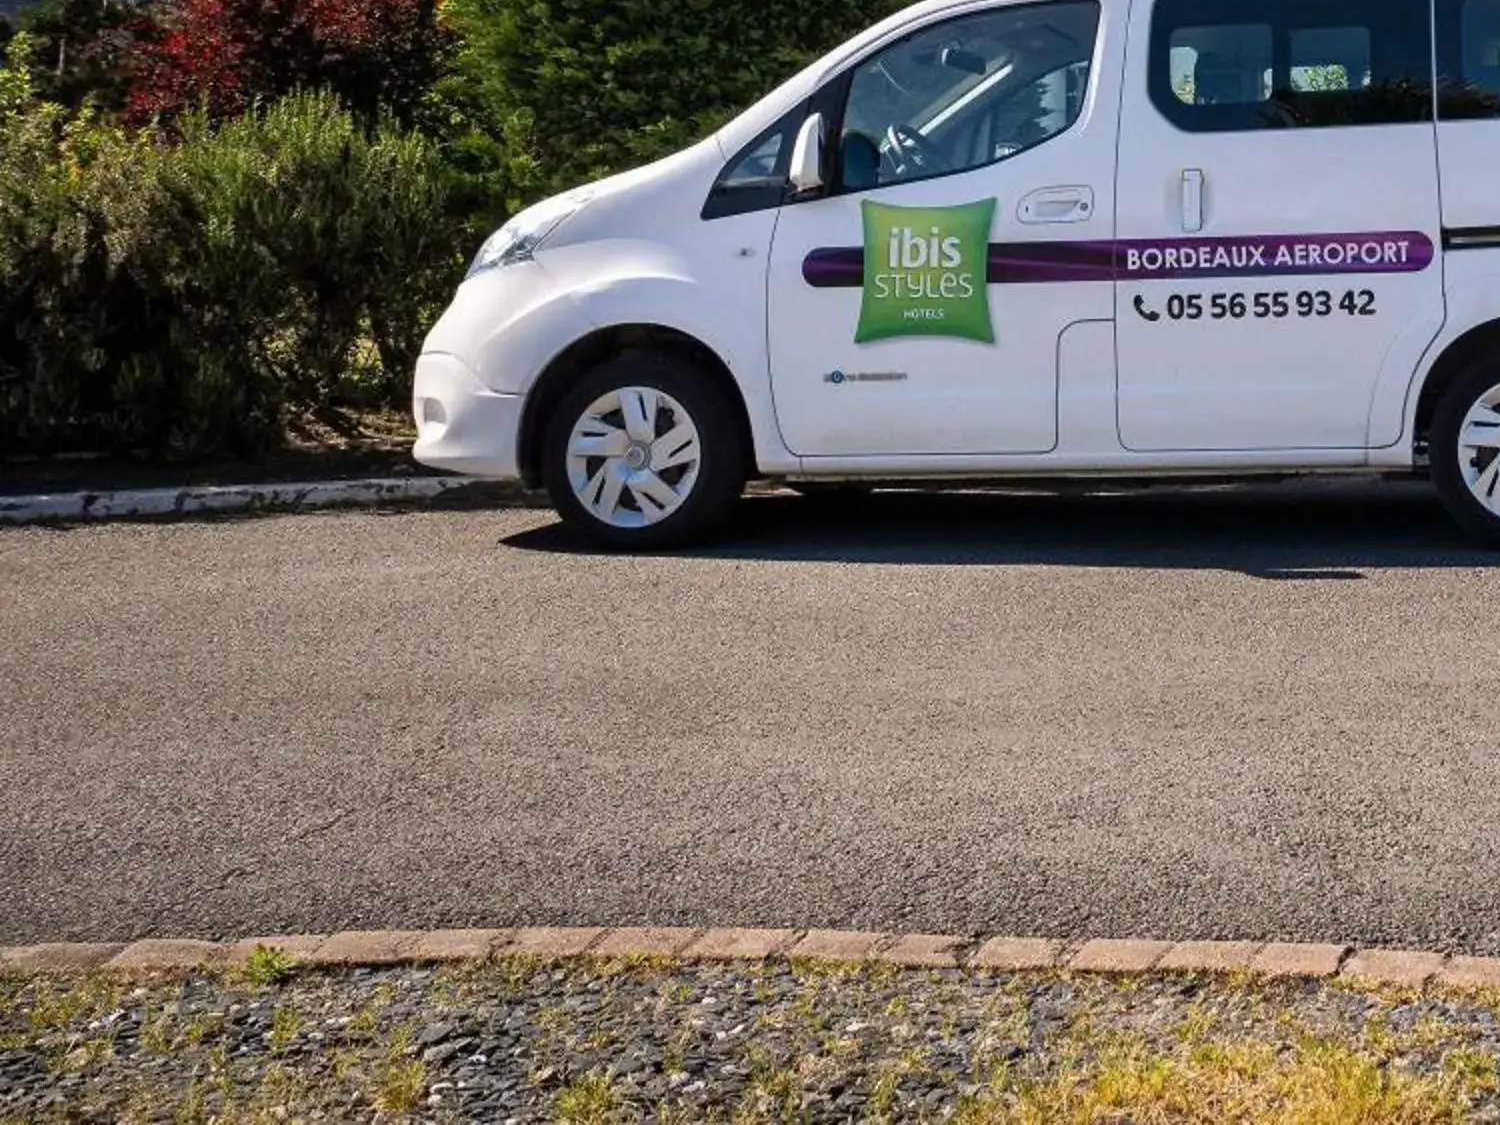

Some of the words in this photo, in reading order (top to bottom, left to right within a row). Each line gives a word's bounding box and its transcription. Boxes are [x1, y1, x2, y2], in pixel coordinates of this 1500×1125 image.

[889, 226, 962, 268] ibis
[1127, 245, 1267, 271] BORDEAUX
[1273, 241, 1409, 267] AEROPORT
[904, 308, 945, 320] HOTELS
[1167, 294, 1203, 320] 05
[1210, 292, 1247, 319] 56
[1253, 291, 1289, 318] 55
[1296, 290, 1332, 317] 93
[1339, 289, 1377, 316] 42
